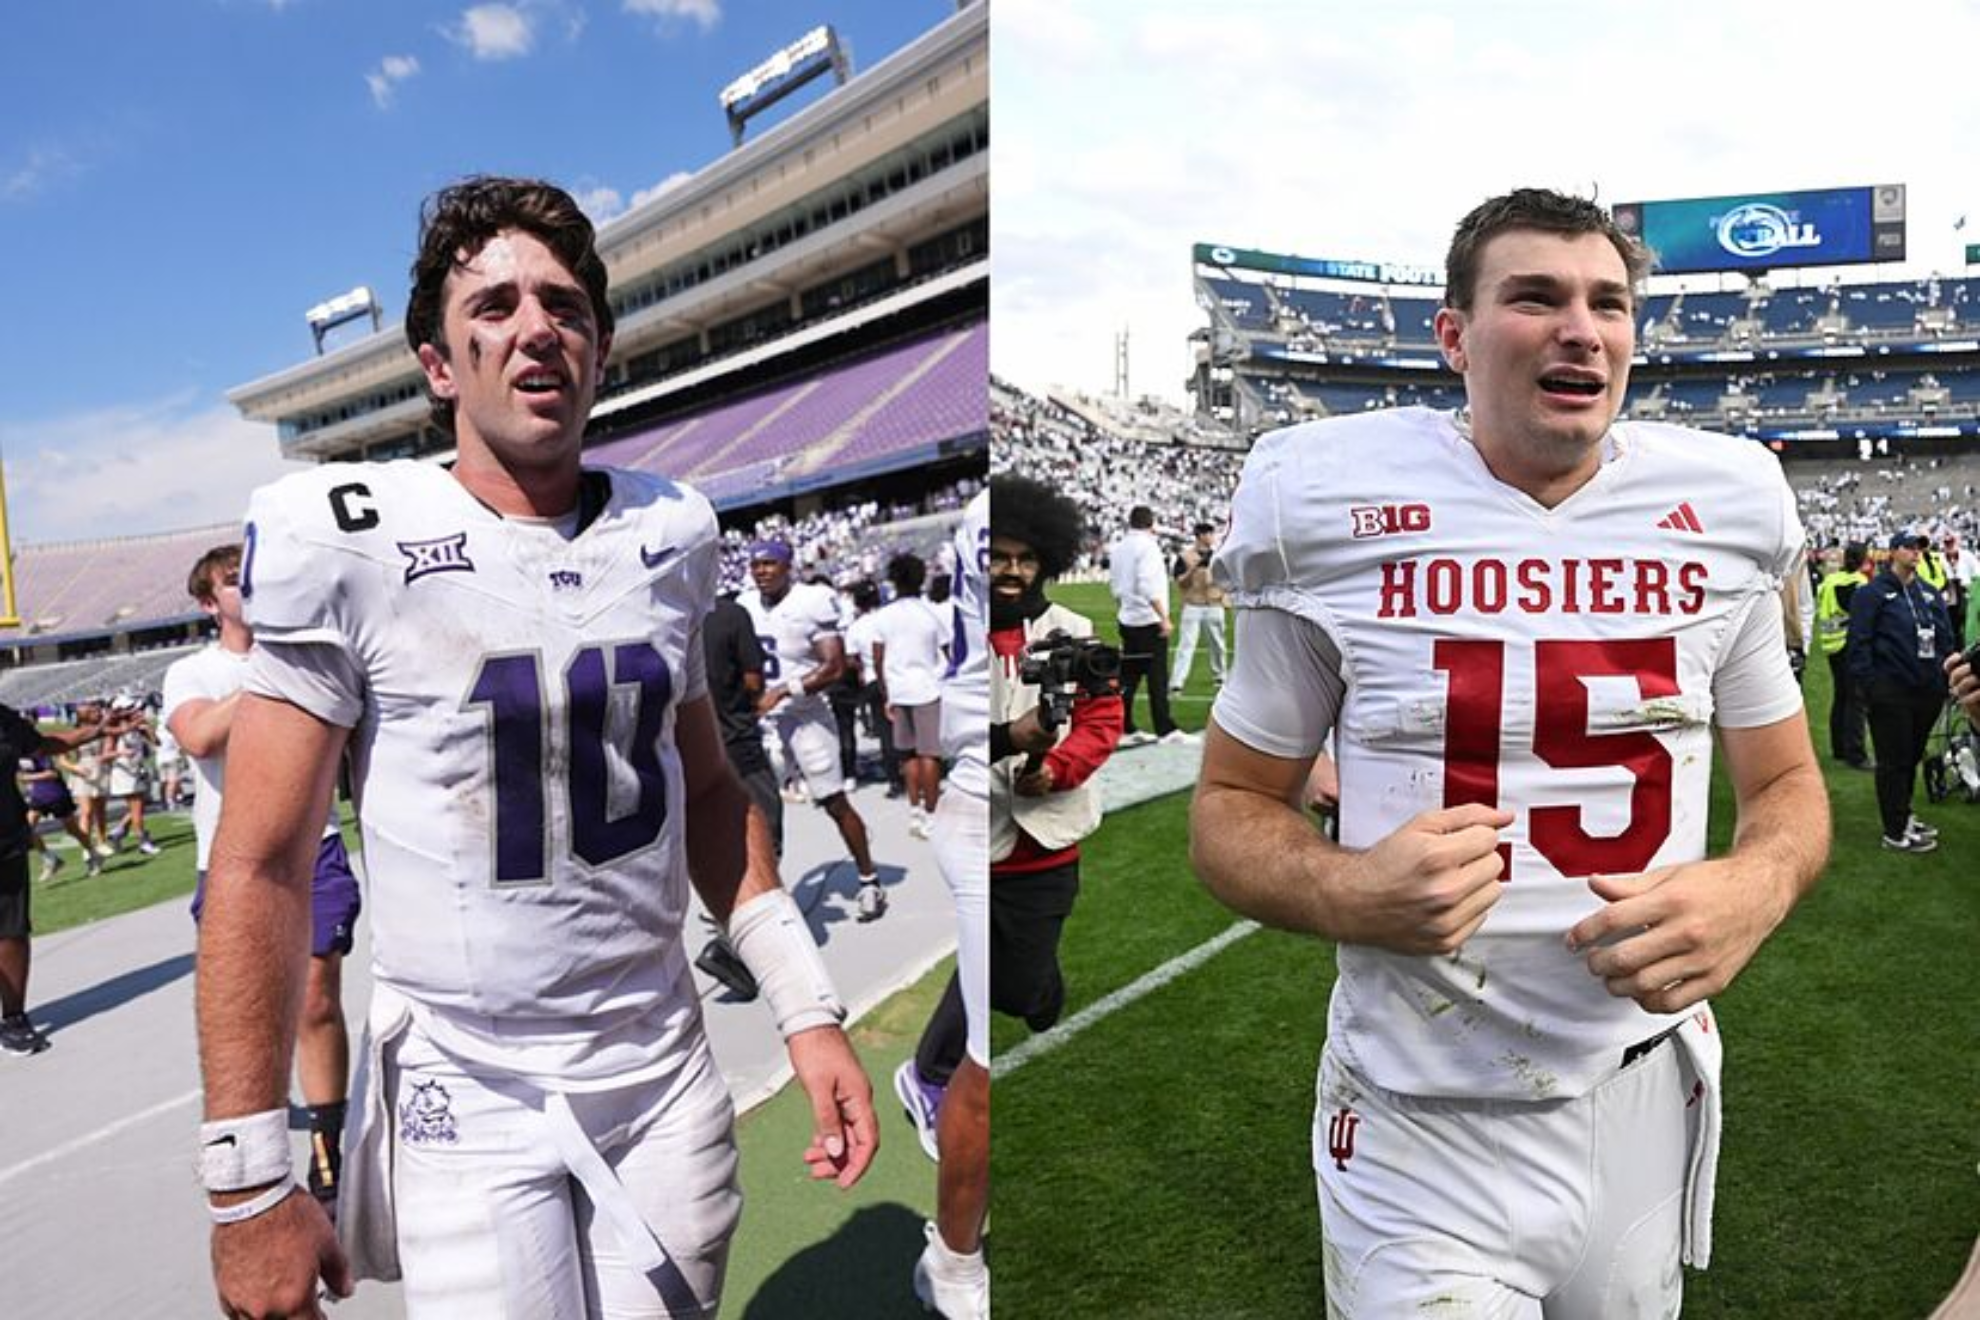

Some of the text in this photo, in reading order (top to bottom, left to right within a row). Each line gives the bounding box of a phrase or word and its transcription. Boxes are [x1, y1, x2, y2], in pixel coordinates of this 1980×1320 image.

[328, 482, 380, 533] C
[549, 571, 581, 588] TCU
[1377, 559, 1708, 618] HOOSIERS
[459, 640, 672, 889] 10
[1433, 636, 1682, 880] 15
